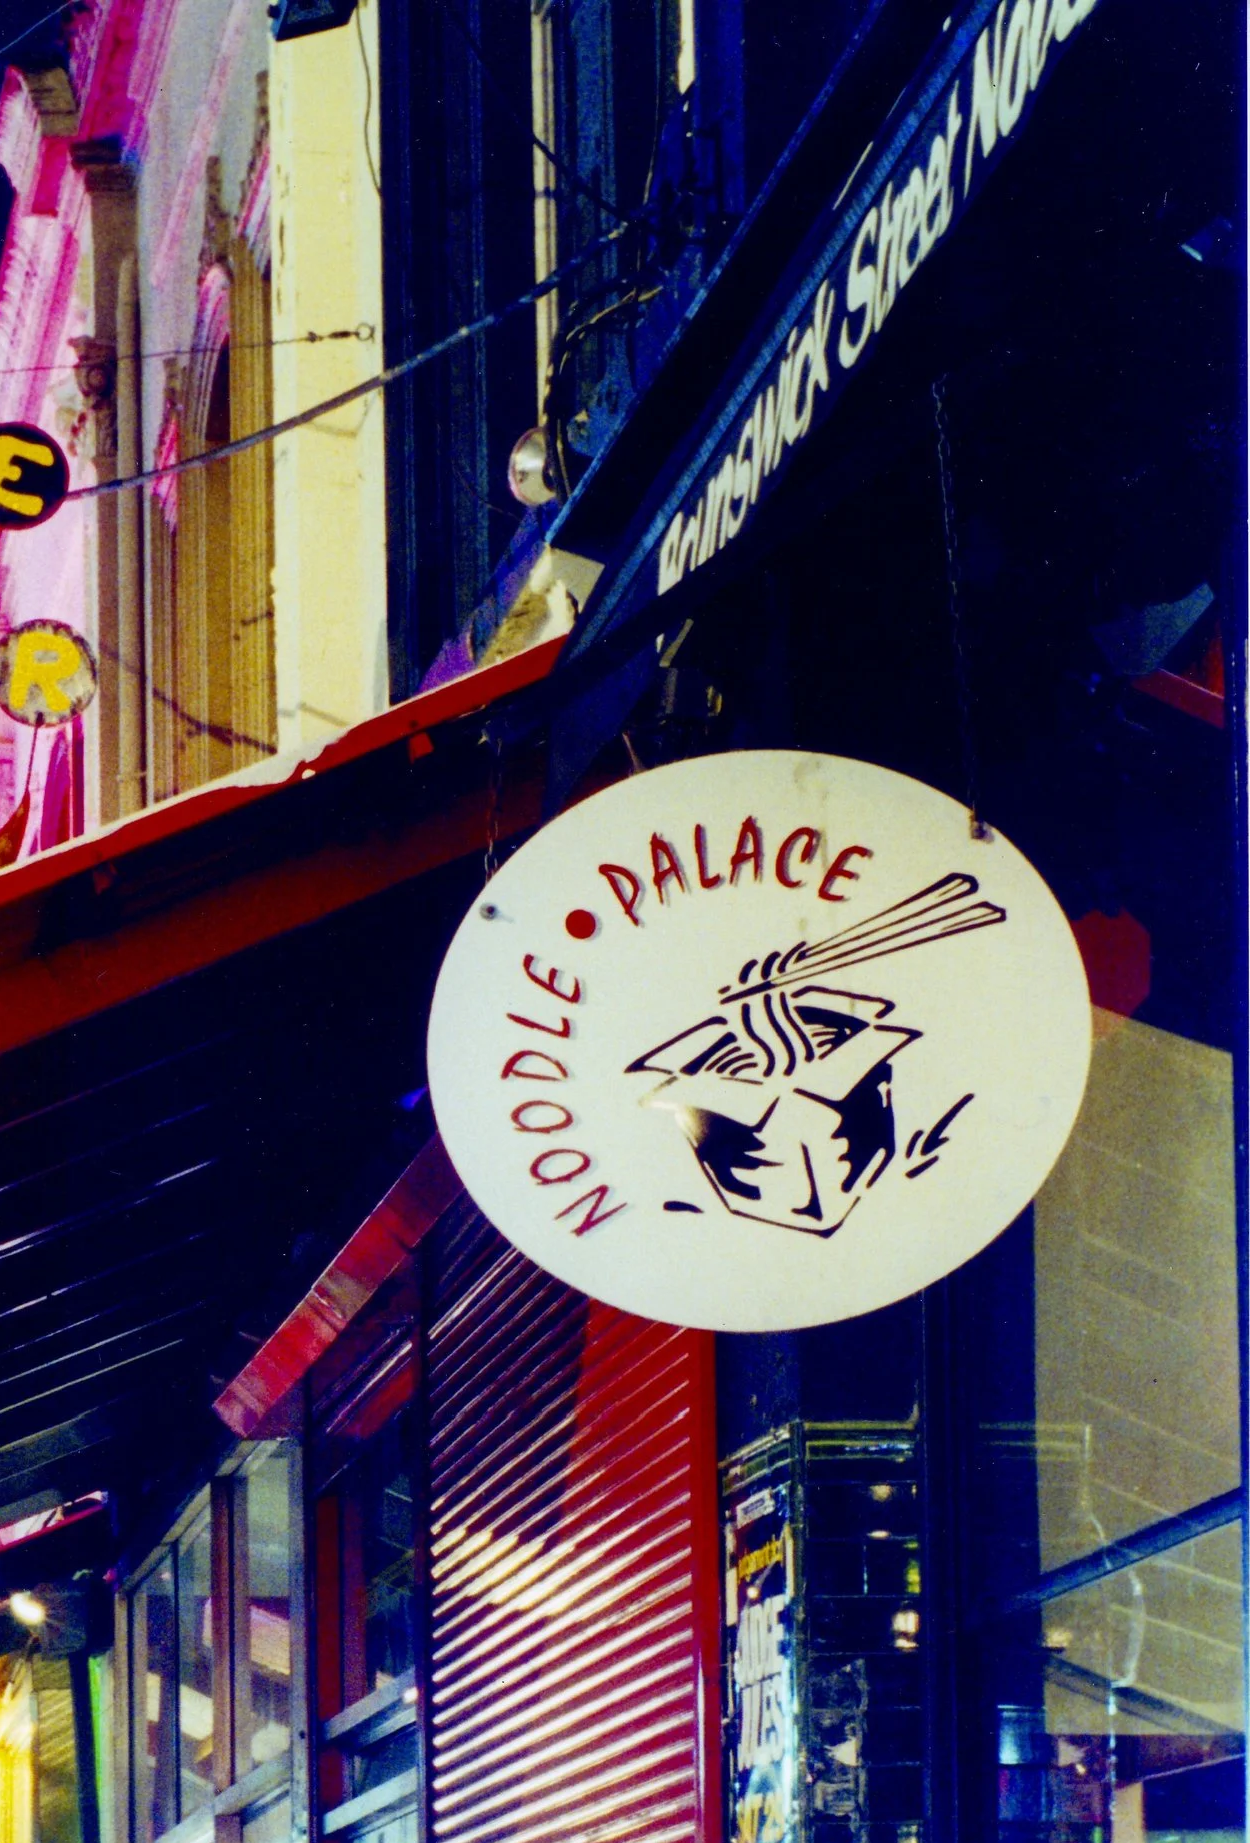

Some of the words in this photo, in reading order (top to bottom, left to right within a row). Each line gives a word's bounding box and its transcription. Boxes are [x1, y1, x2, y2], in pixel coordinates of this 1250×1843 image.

[838, 79, 963, 369] Street
[500, 952, 628, 1238] NOODLE
[597, 815, 874, 928] PALACE
